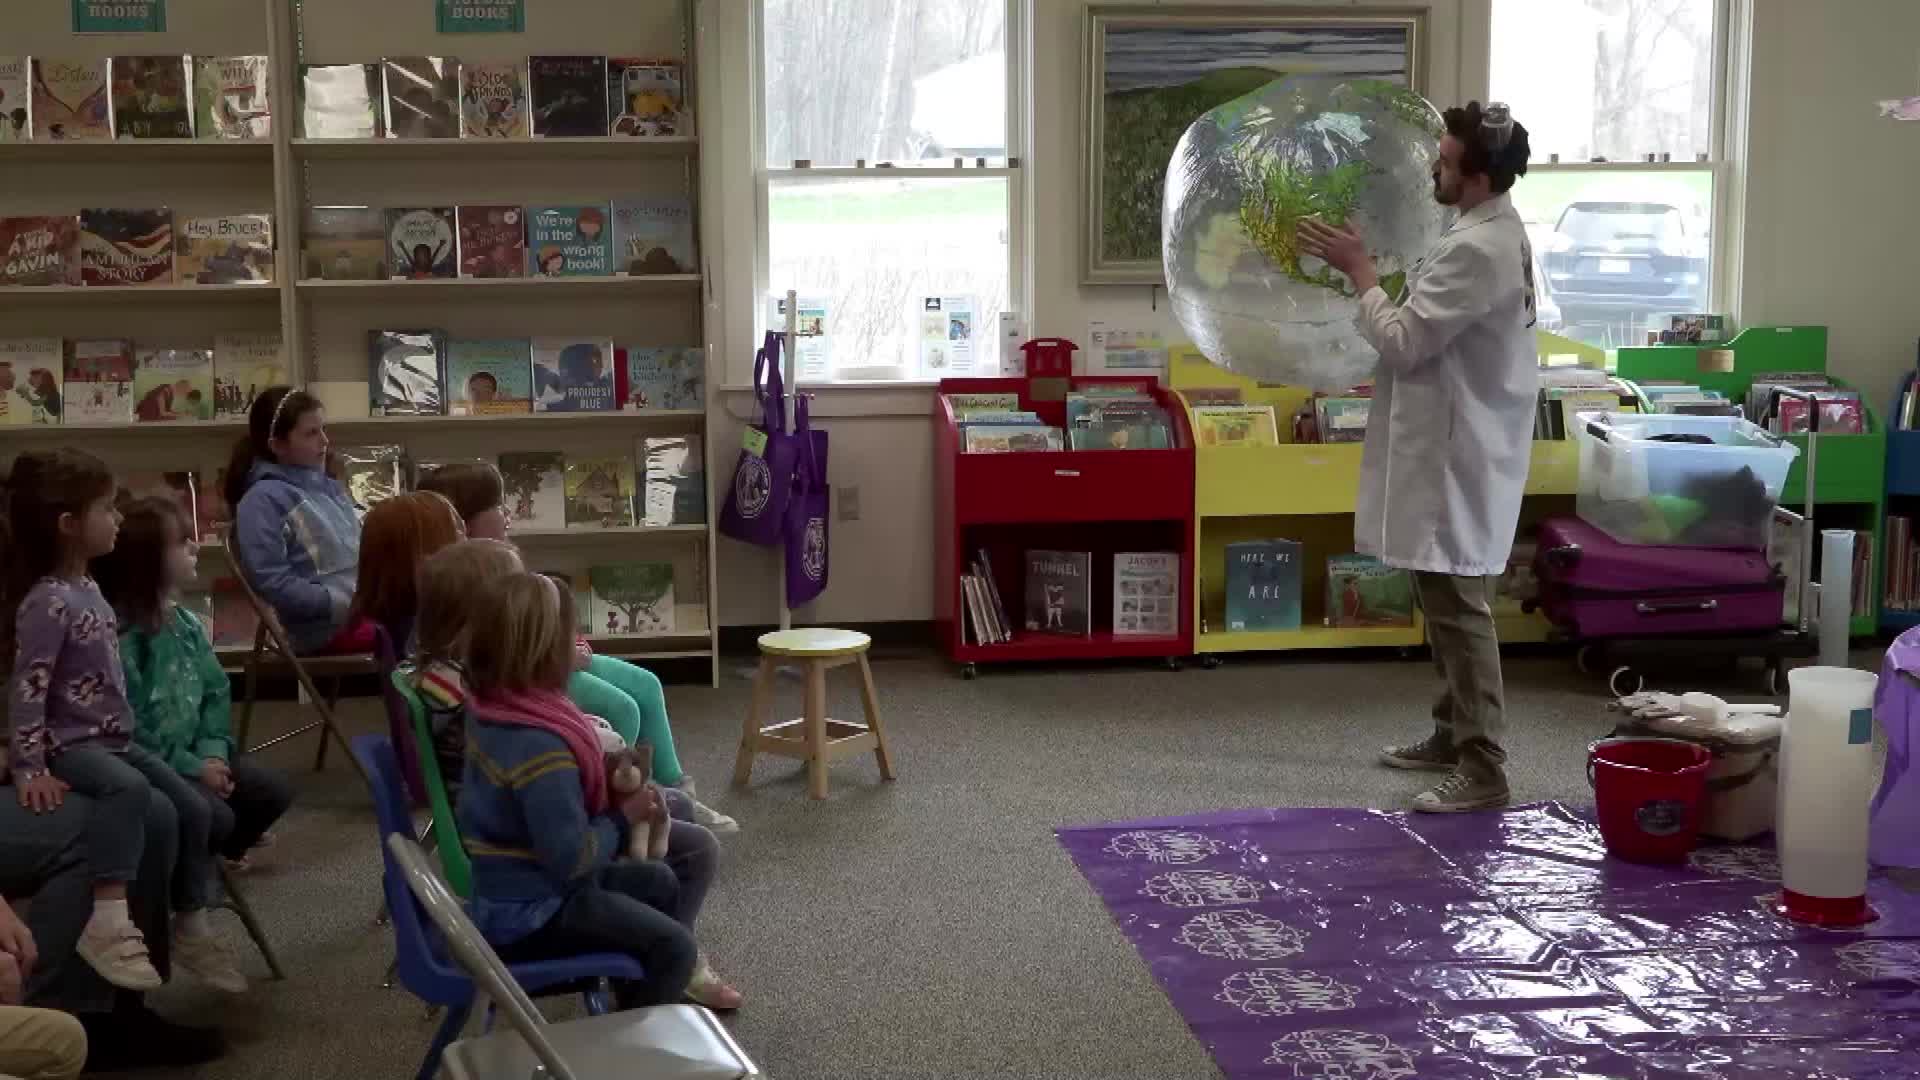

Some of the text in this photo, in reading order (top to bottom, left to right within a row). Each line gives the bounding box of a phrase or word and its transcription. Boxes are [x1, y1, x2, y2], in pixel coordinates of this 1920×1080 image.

[88, 5, 148, 17] BOOKS
[451, 6, 510, 18] BOOKS
[535, 215, 575, 227] We're
[536, 229, 575, 241] in the
[563, 245, 605, 261] wrong
[6, 251, 60, 275] GAVIN
[86, 254, 168, 265] AMERICAN
[567, 257, 606, 271] book!
[96, 267, 147, 281] STORY
[568, 387, 611, 400] PROUDEST
[580, 399, 601, 409] BLUE
[1240, 553, 1290, 563] HERE WE
[1031, 560, 1081, 577] TUNNEL
[1248, 585, 1280, 599] ARE
